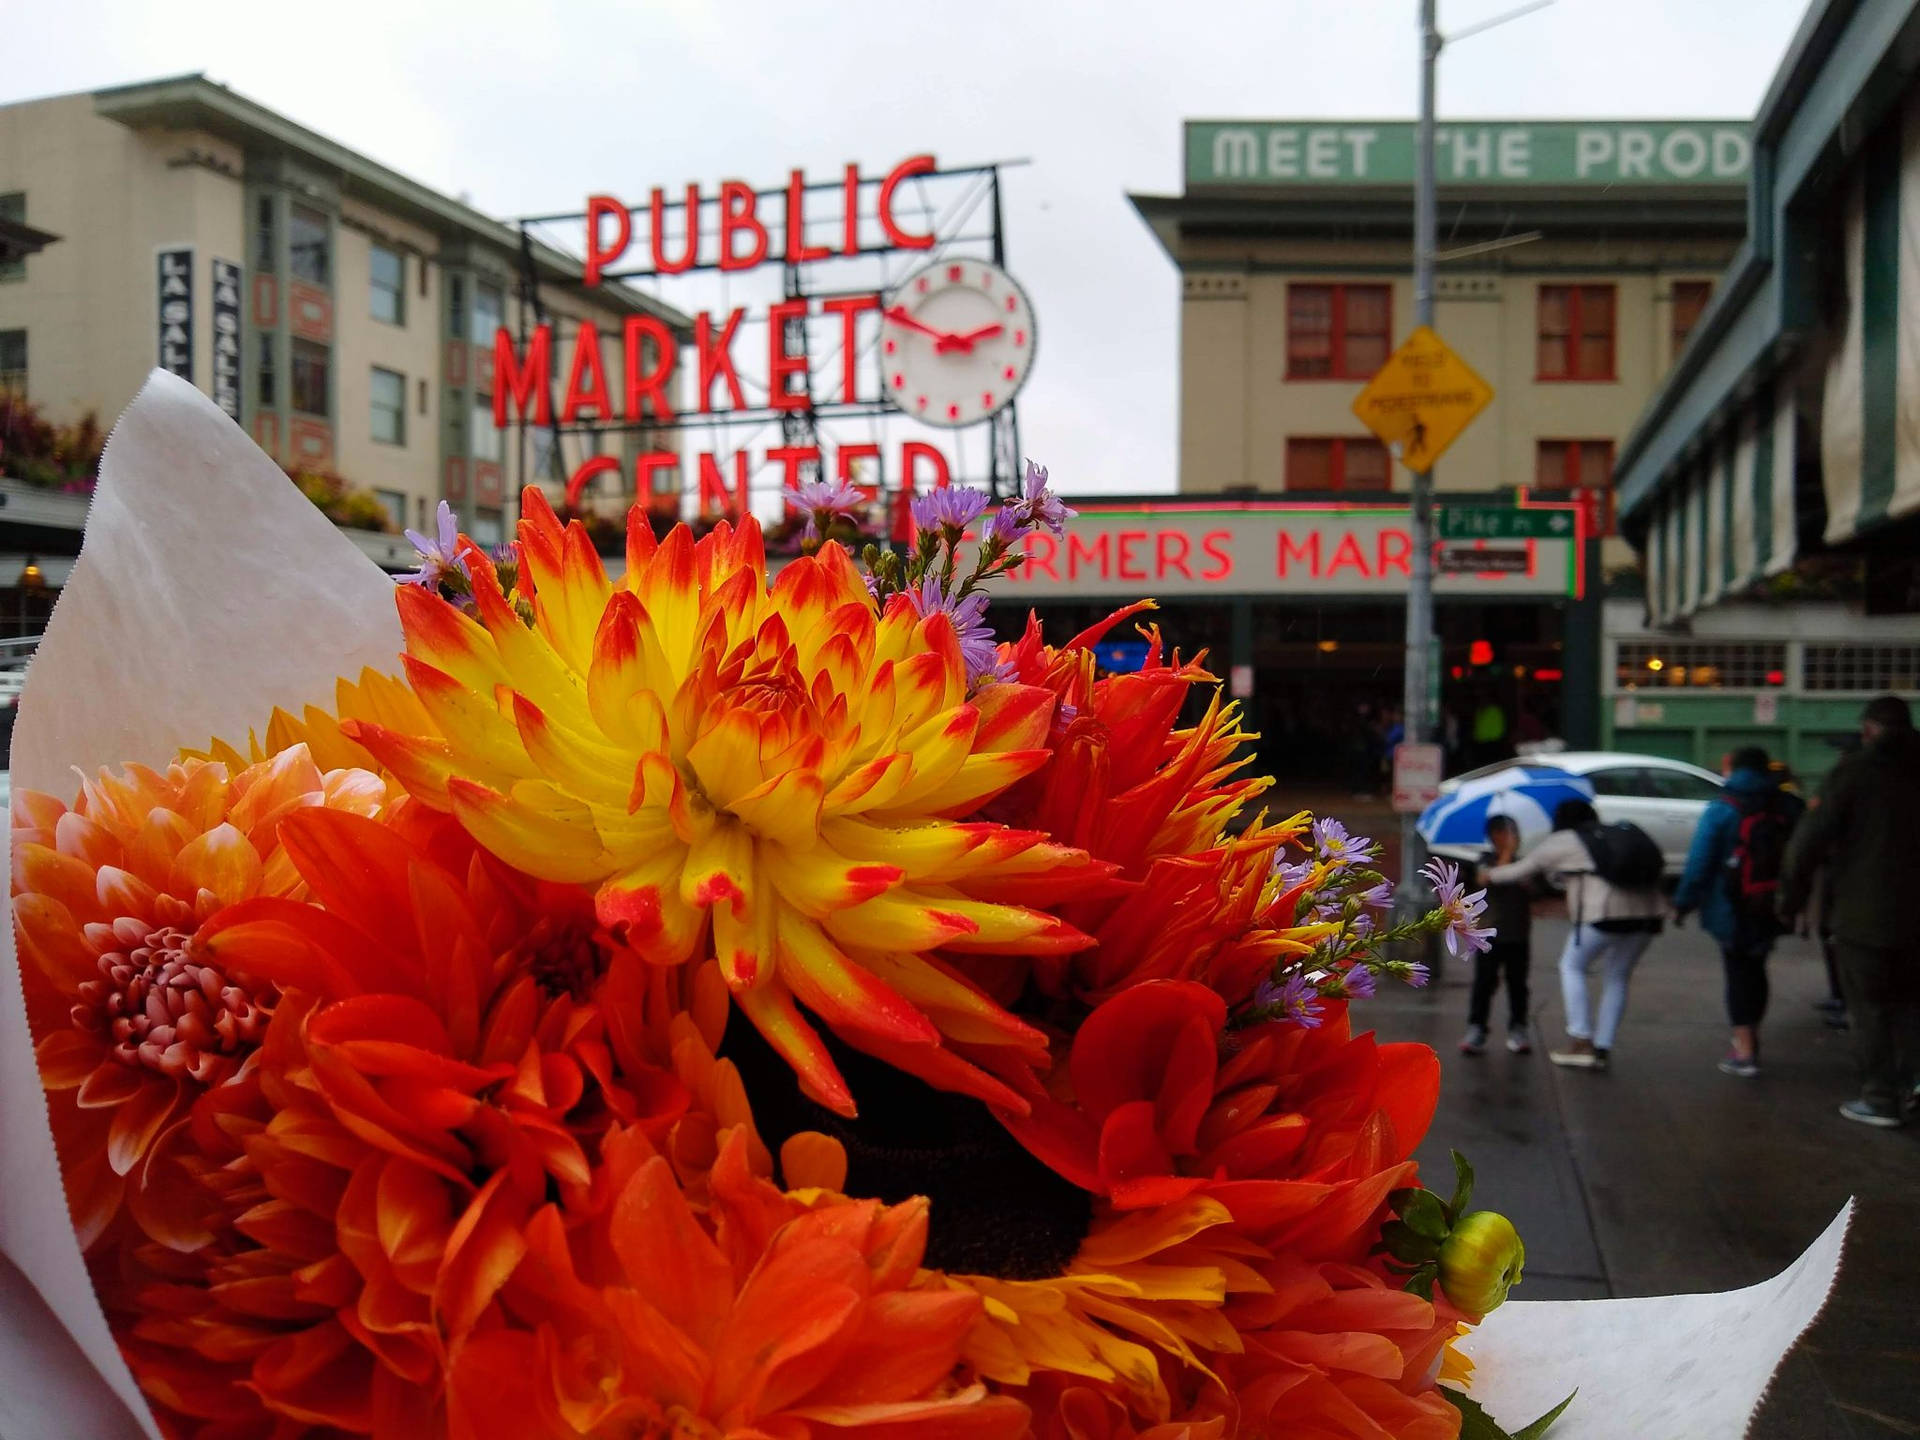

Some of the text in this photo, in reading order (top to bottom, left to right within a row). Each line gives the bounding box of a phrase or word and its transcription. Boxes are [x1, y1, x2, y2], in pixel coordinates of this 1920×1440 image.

[1212, 128, 1377, 178] MEET
[1574, 128, 1750, 178] PROD
[584, 155, 937, 286] PUBLIC
[162, 252, 188, 298] LA
[214, 262, 237, 308] LA
[492, 293, 881, 429] MARKET
[1447, 506, 1500, 535] Pike
